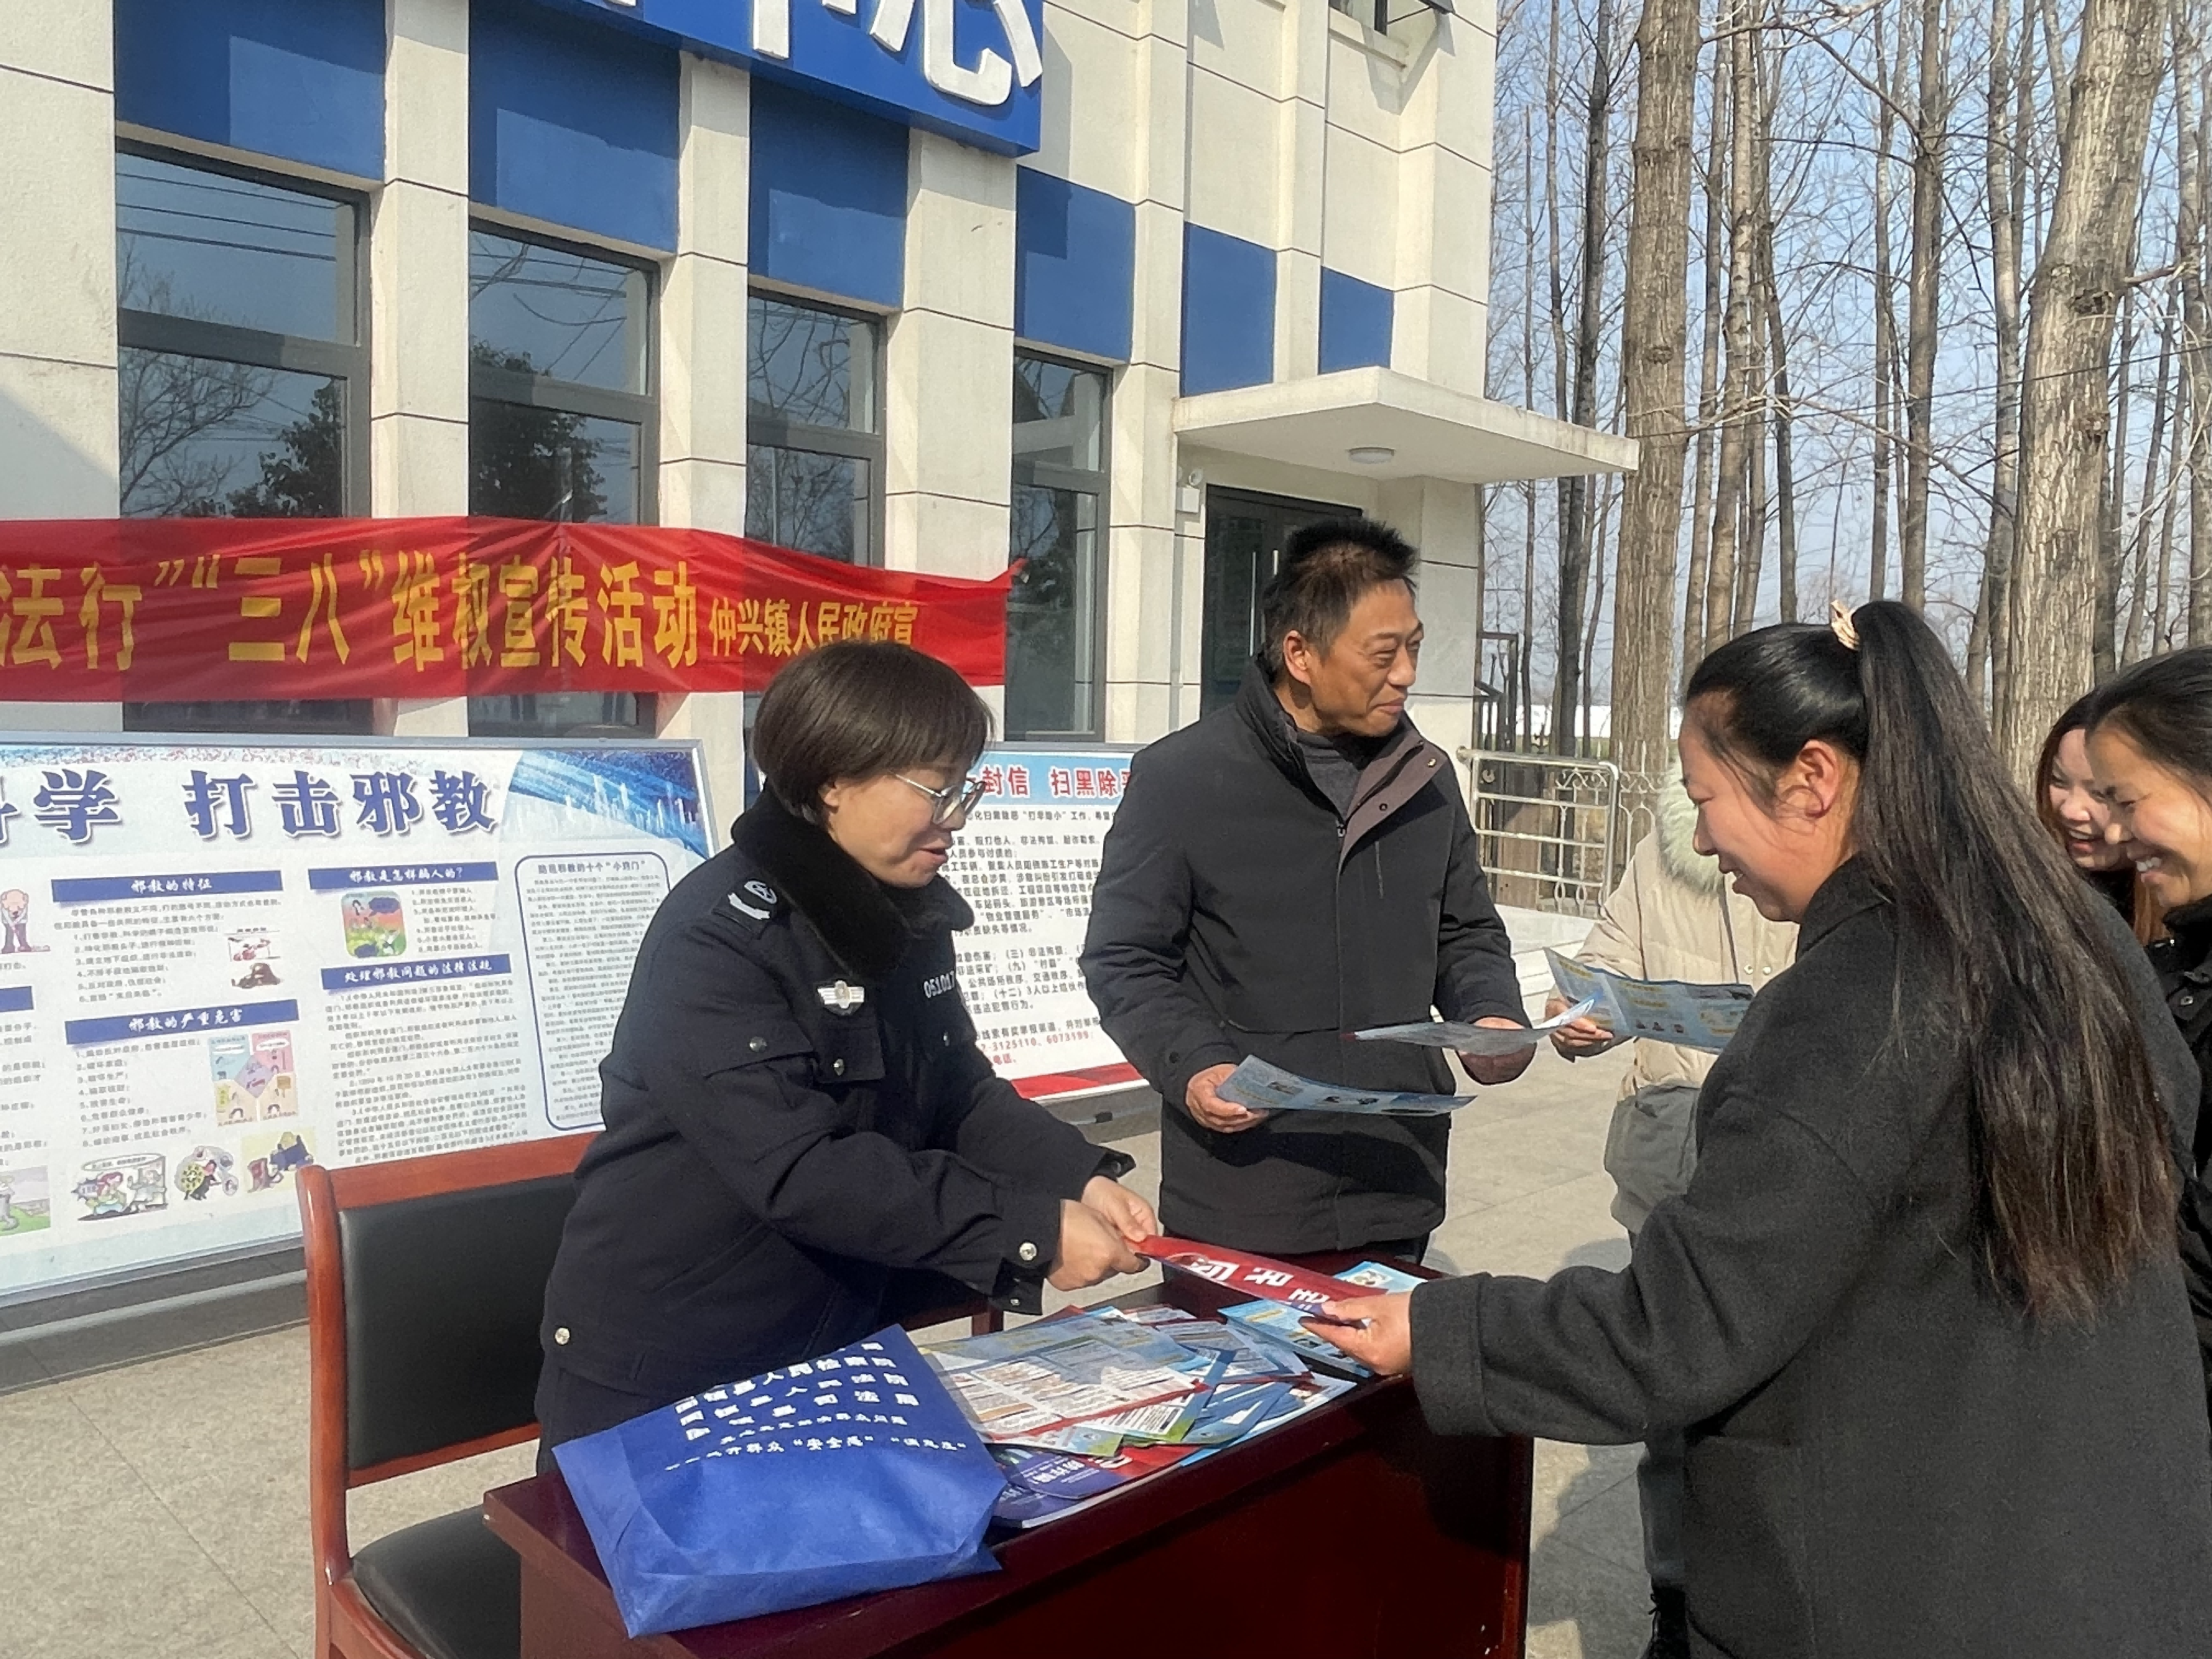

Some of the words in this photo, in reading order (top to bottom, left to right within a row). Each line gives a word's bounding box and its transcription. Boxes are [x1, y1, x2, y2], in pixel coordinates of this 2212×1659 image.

[967, 766, 1029, 796] 封信
[182, 769, 494, 838] 打击邪教
[131, 877, 212, 894] 邪教的特征
